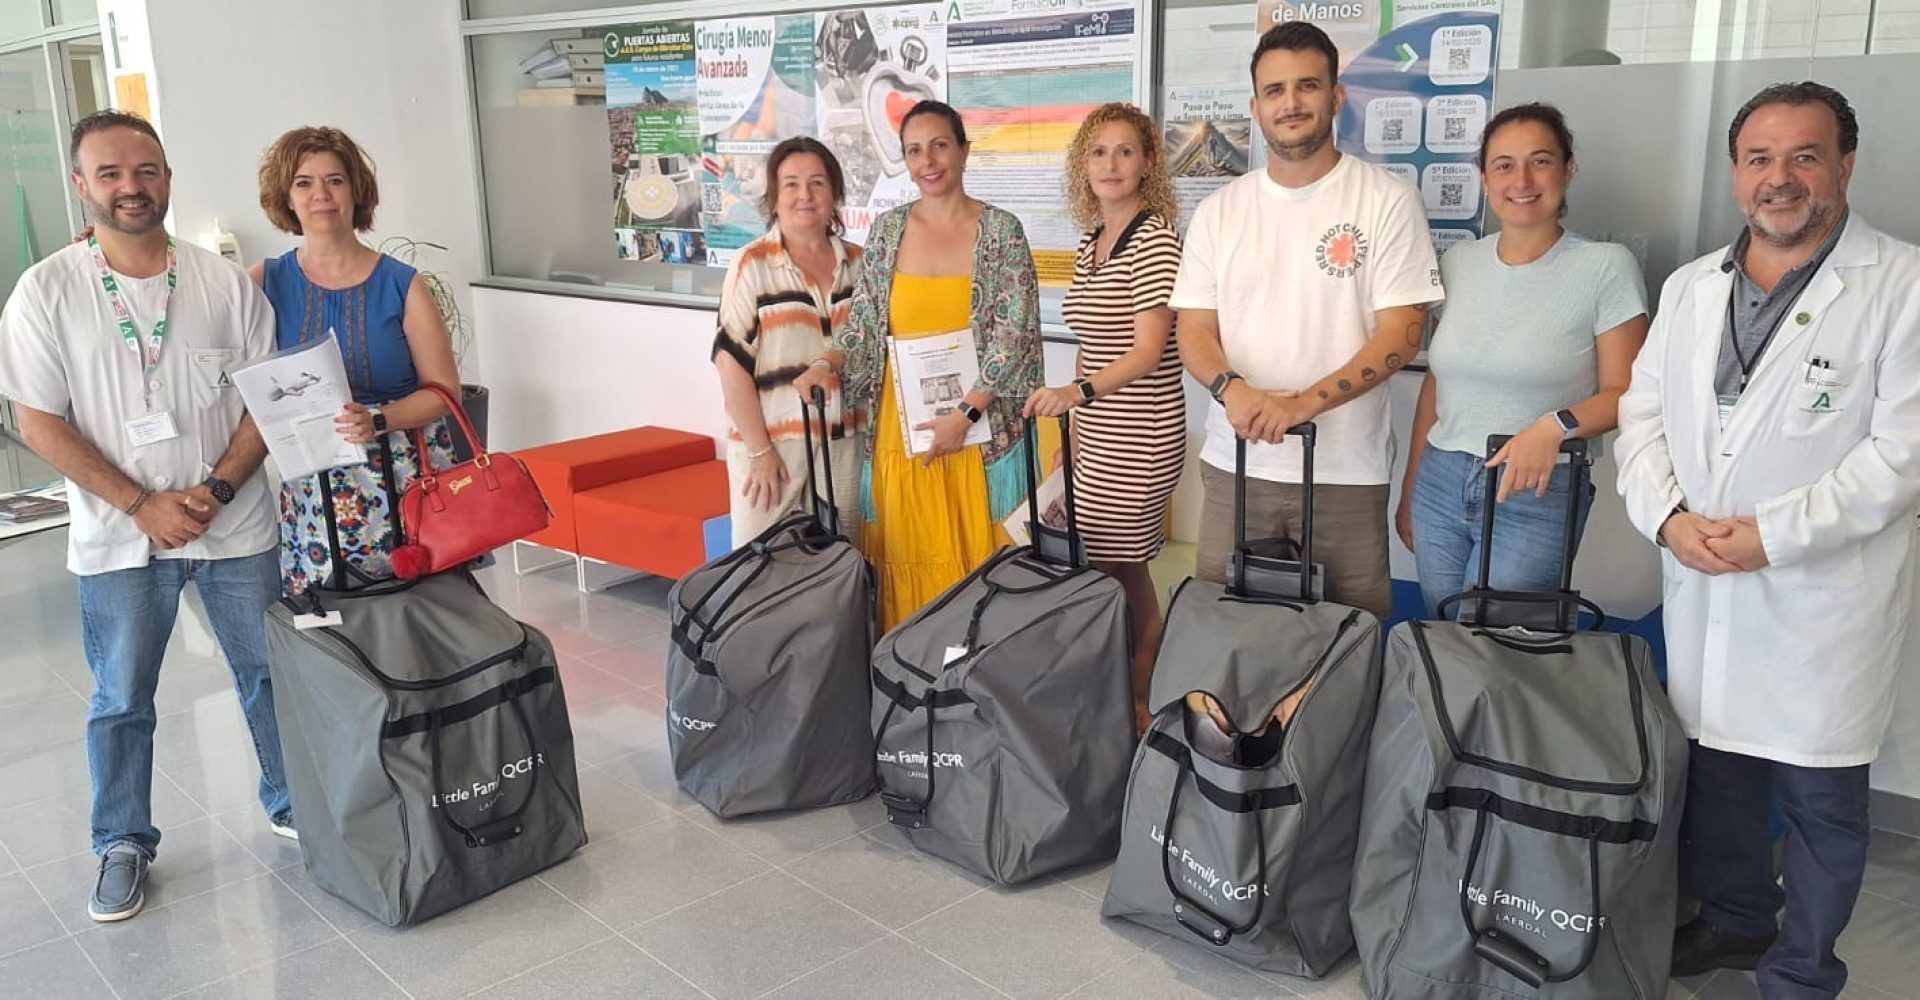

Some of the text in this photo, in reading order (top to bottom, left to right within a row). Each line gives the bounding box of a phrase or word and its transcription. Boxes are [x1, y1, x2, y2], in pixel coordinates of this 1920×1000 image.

[1271, 2, 1363, 23] de Manos
[623, 32, 691, 46] PUERTAS ABIERTAS
[696, 22, 772, 55] Cirugía Menor
[697, 54, 748, 79] Avanzada
[1442, 165, 1471, 174] Edición
[1320, 223, 1342, 244] HOT
[1315, 244, 1329, 270] RED
[898, 750, 929, 769] Family
[431, 788, 470, 808] Lttle
[1181, 848, 1221, 889] Family
[1182, 873, 1221, 906] LAERDAL
[1492, 889, 1546, 921] Family
[1495, 913, 1548, 939] LAERDAL
